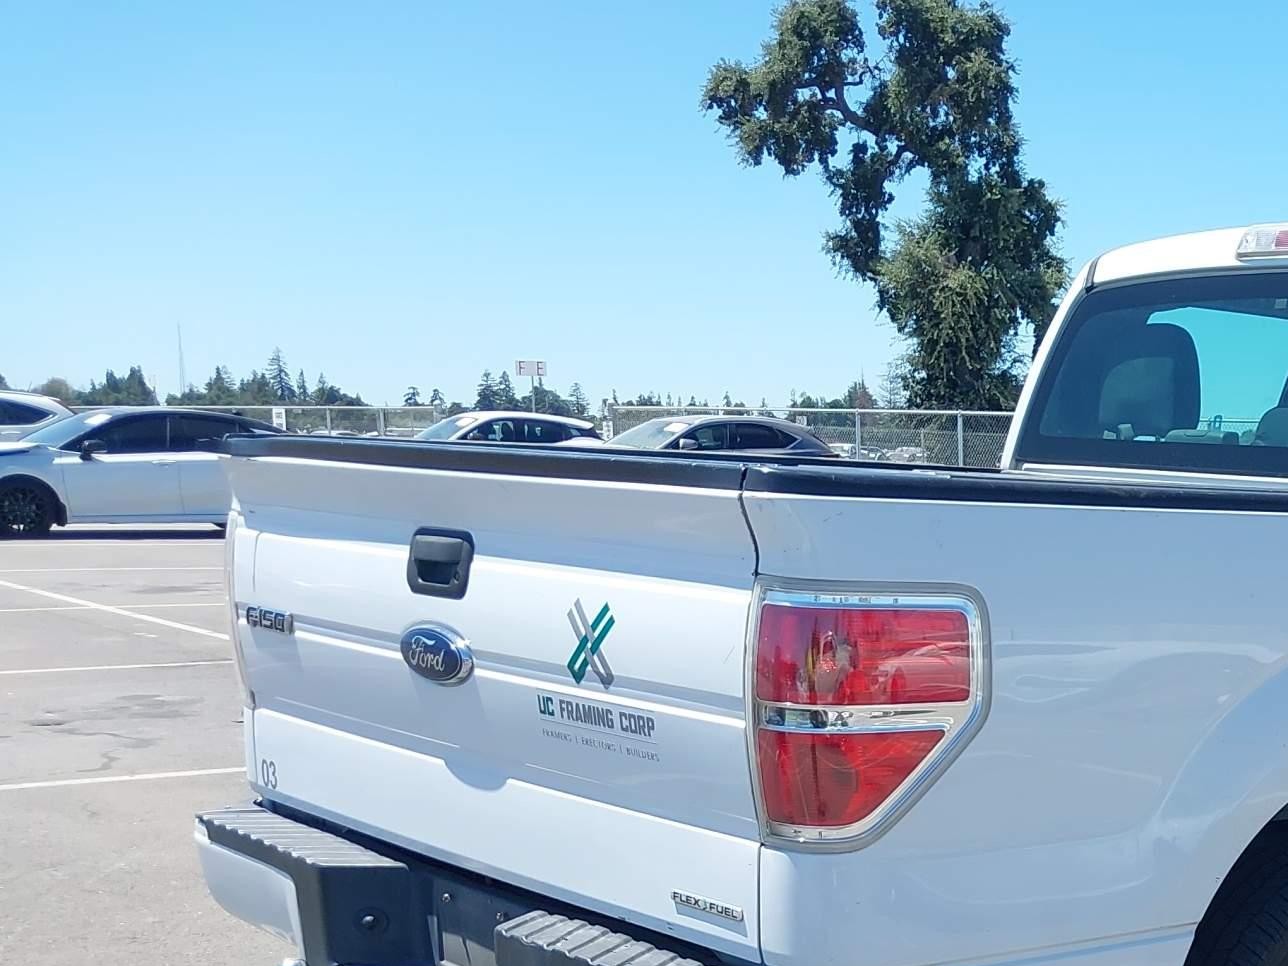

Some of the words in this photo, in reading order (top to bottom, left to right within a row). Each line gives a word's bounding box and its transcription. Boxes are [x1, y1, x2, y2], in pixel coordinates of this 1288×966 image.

[536, 360, 545, 376] E
[409, 635, 445, 672] Ford
[537, 694, 555, 717] UC
[559, 698, 615, 729] FRAMING
[619, 711, 656, 737] CORP
[627, 747, 660, 762] BUILDERS
[261, 758, 278, 790] 03
[673, 891, 701, 908] FLEX
[709, 902, 739, 919] FUEL
